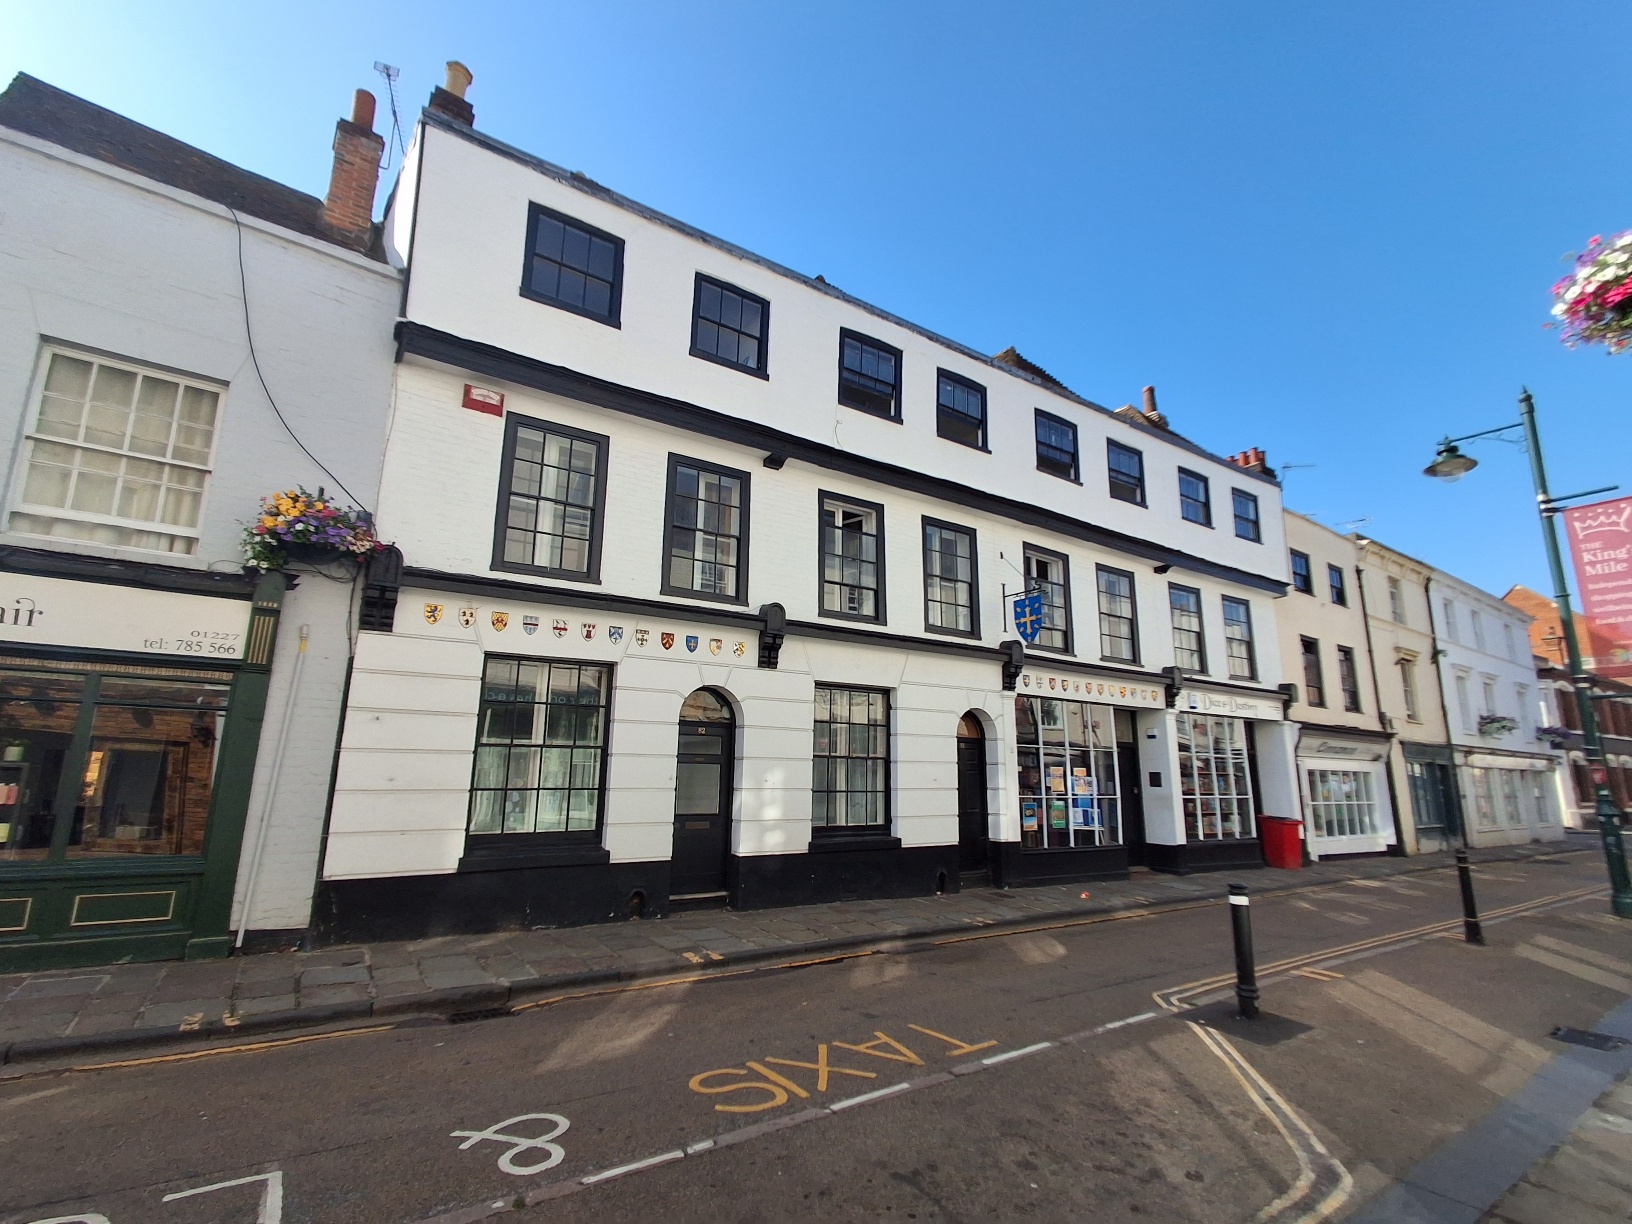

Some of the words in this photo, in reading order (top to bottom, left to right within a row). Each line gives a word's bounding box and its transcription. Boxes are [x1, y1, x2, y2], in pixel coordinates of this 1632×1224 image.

[1584, 561, 1630, 577] Mile
[190, 630, 240, 641] 01227
[143, 638, 169, 650] tel:
[175, 639, 203, 653] 785
[208, 643, 236, 655] 566
[688, 1024, 998, 1112] TAXIS
